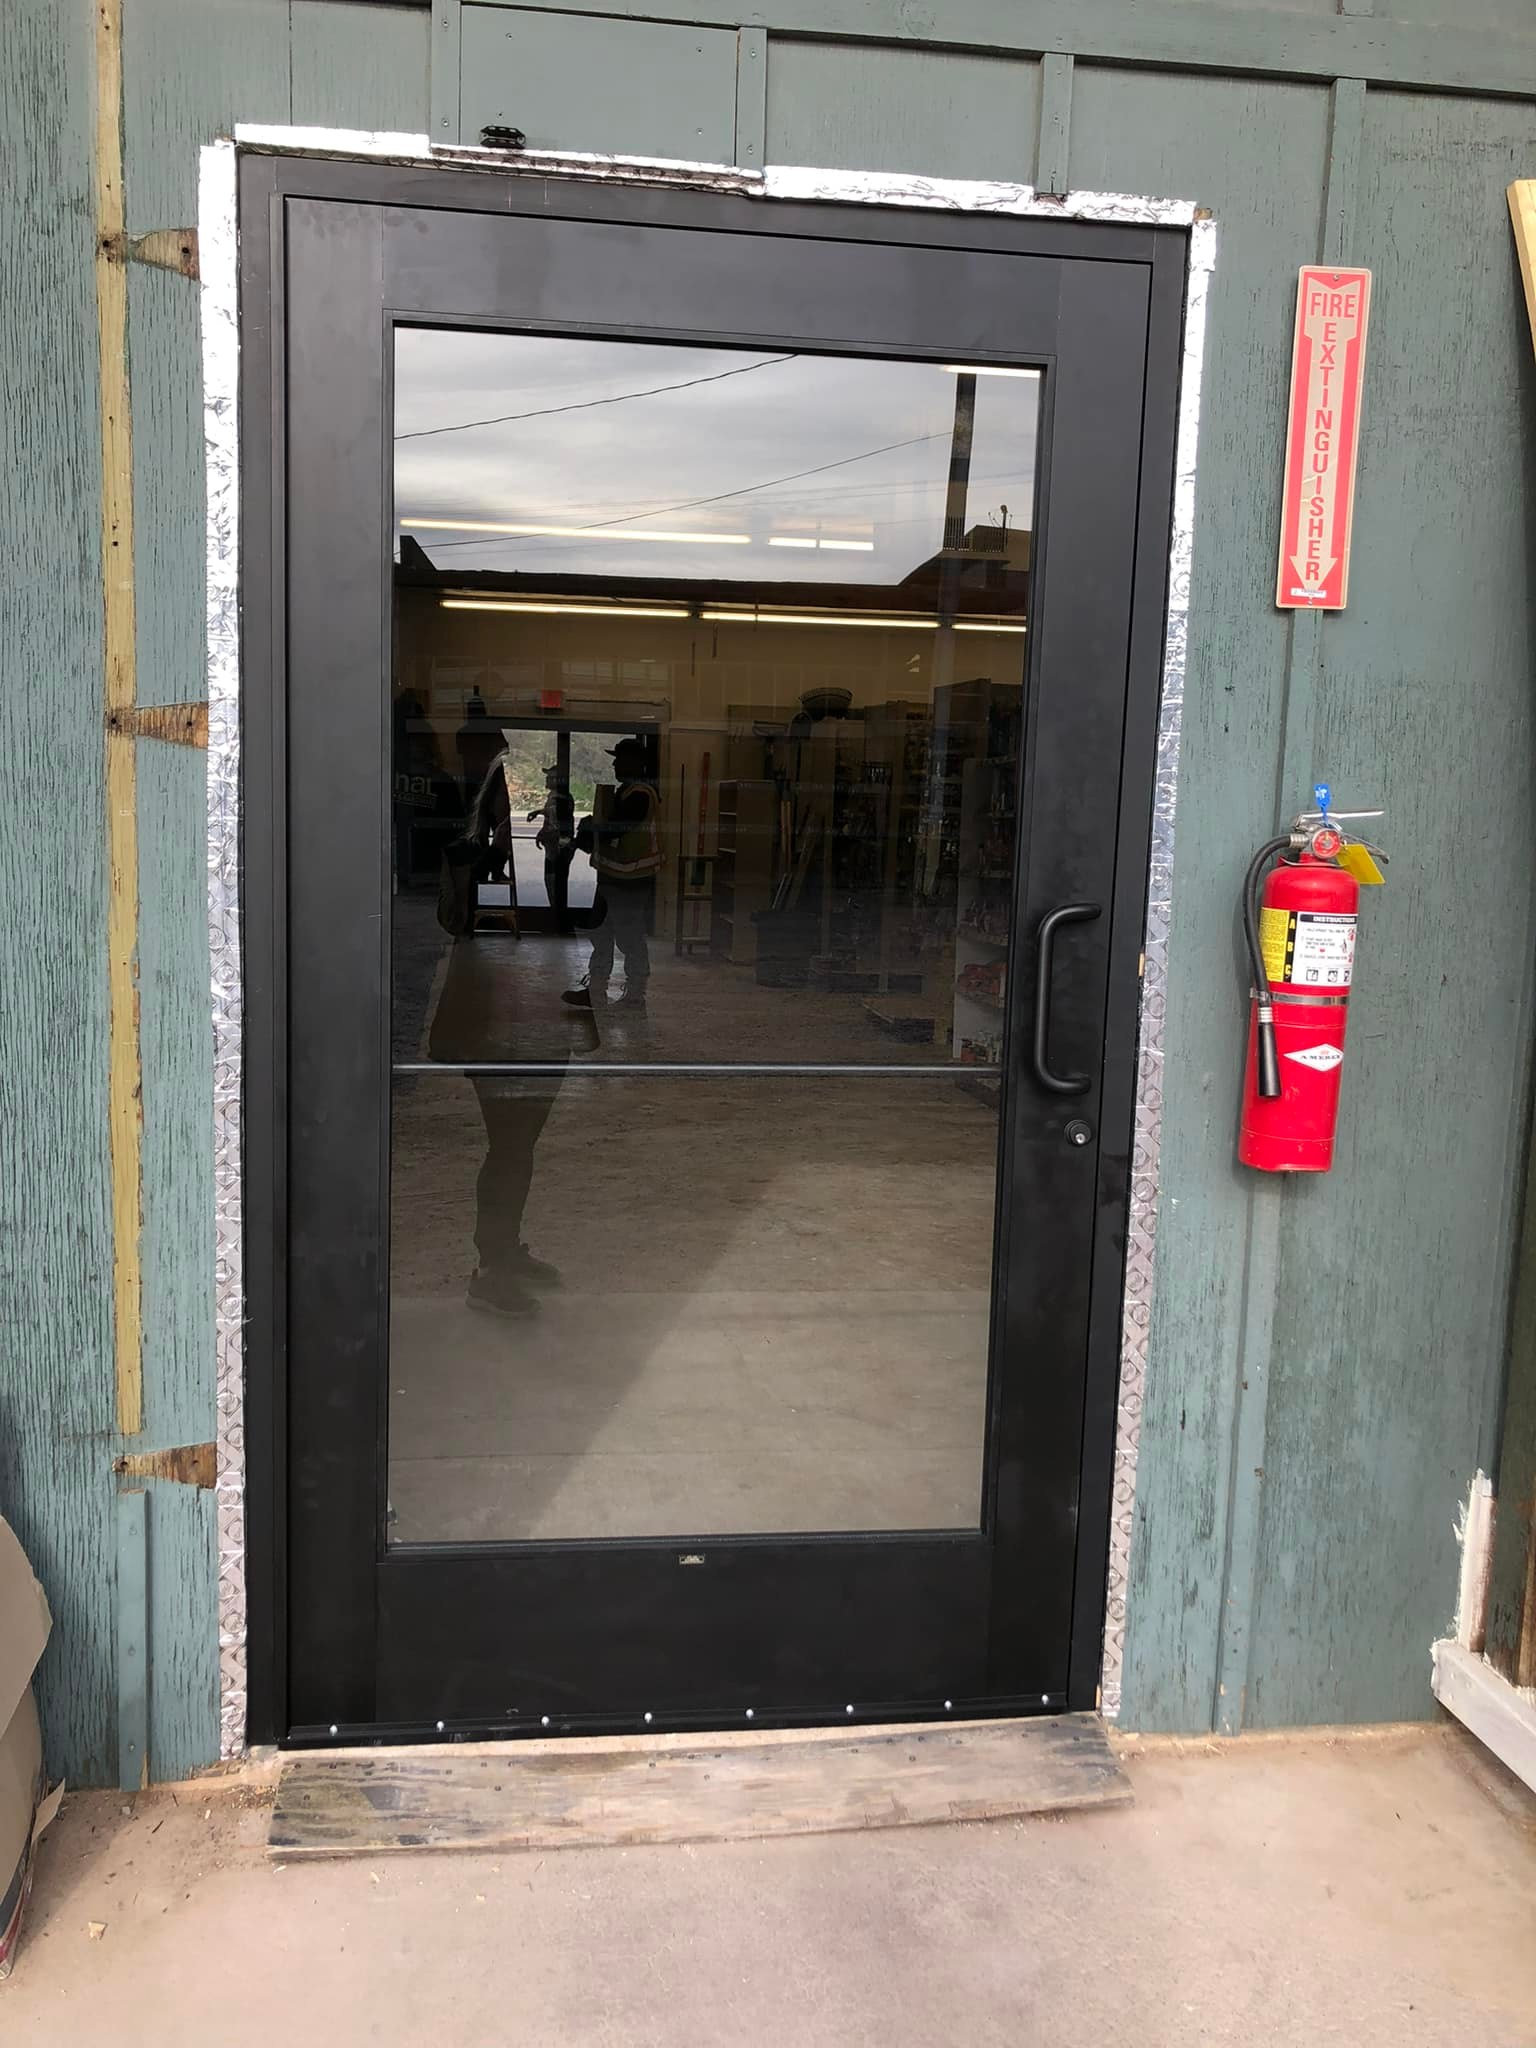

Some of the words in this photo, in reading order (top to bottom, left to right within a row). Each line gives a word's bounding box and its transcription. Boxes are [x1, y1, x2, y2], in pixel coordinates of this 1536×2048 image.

[1309, 292, 1357, 319] FIRE
[1305, 321, 1337, 582] EXTINGUISHER
[1288, 918, 1296, 930] A
[1287, 941, 1294, 952] B
[1285, 964, 1292, 975] C
